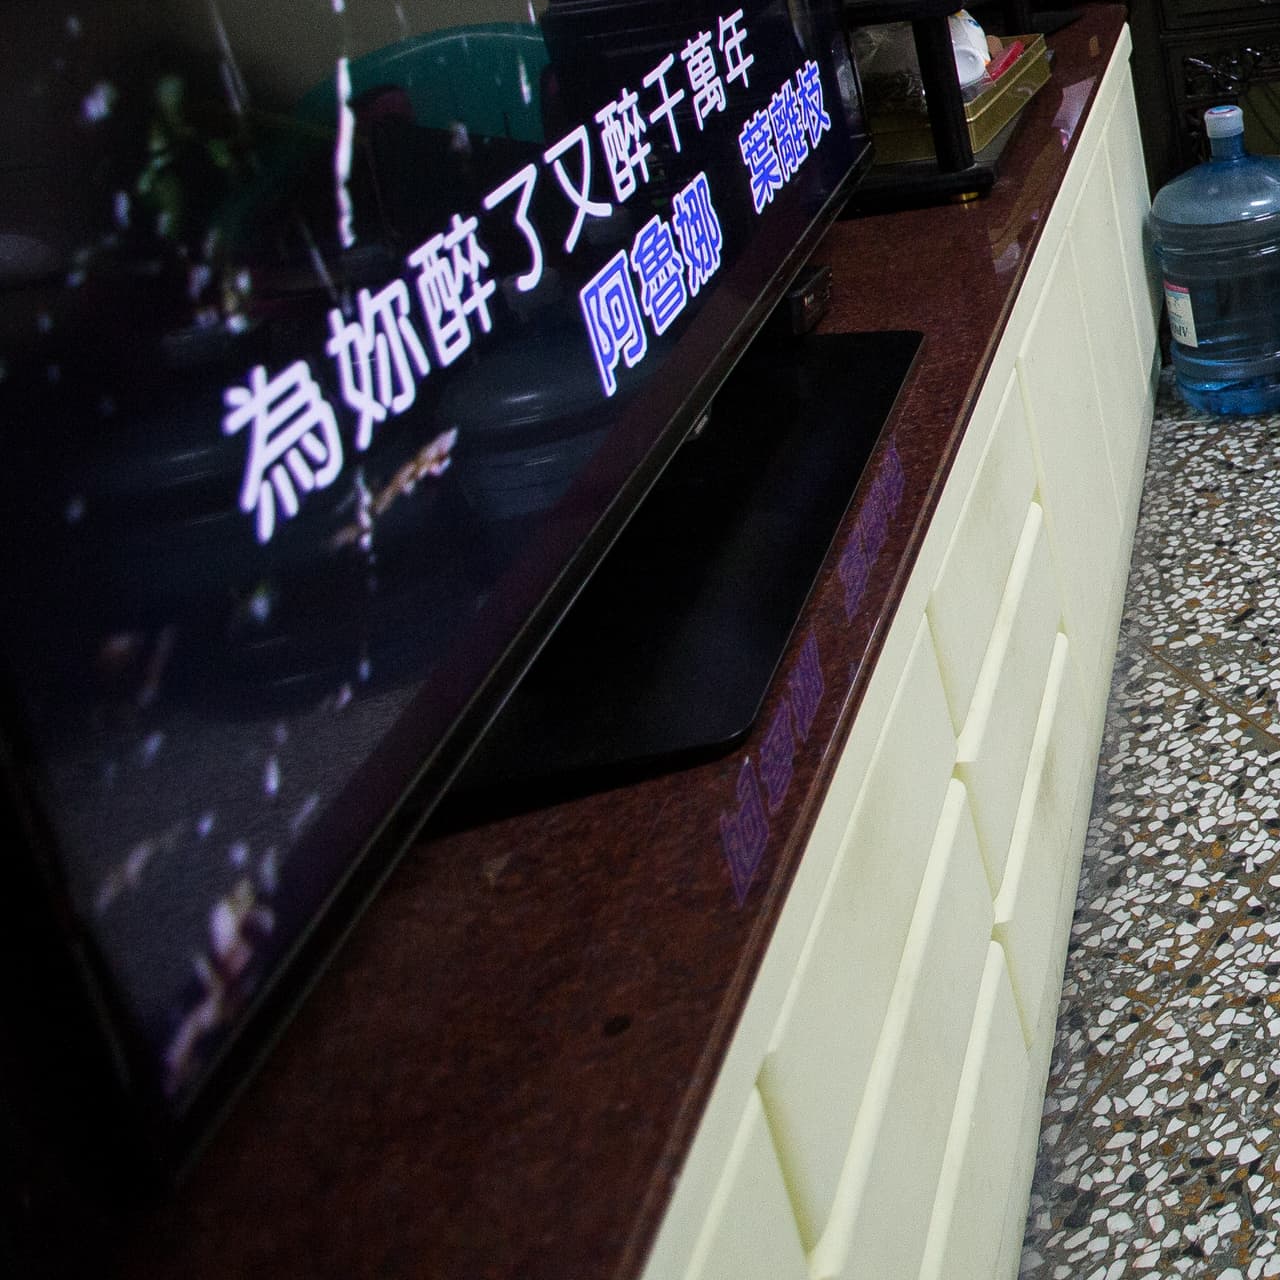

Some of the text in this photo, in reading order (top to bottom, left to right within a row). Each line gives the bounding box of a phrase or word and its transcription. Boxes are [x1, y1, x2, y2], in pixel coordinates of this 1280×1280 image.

[223, 8, 755, 544] 為妳醉了又醉千萬年
[579, 59, 832, 397] 阿魯娜 葉離枝
